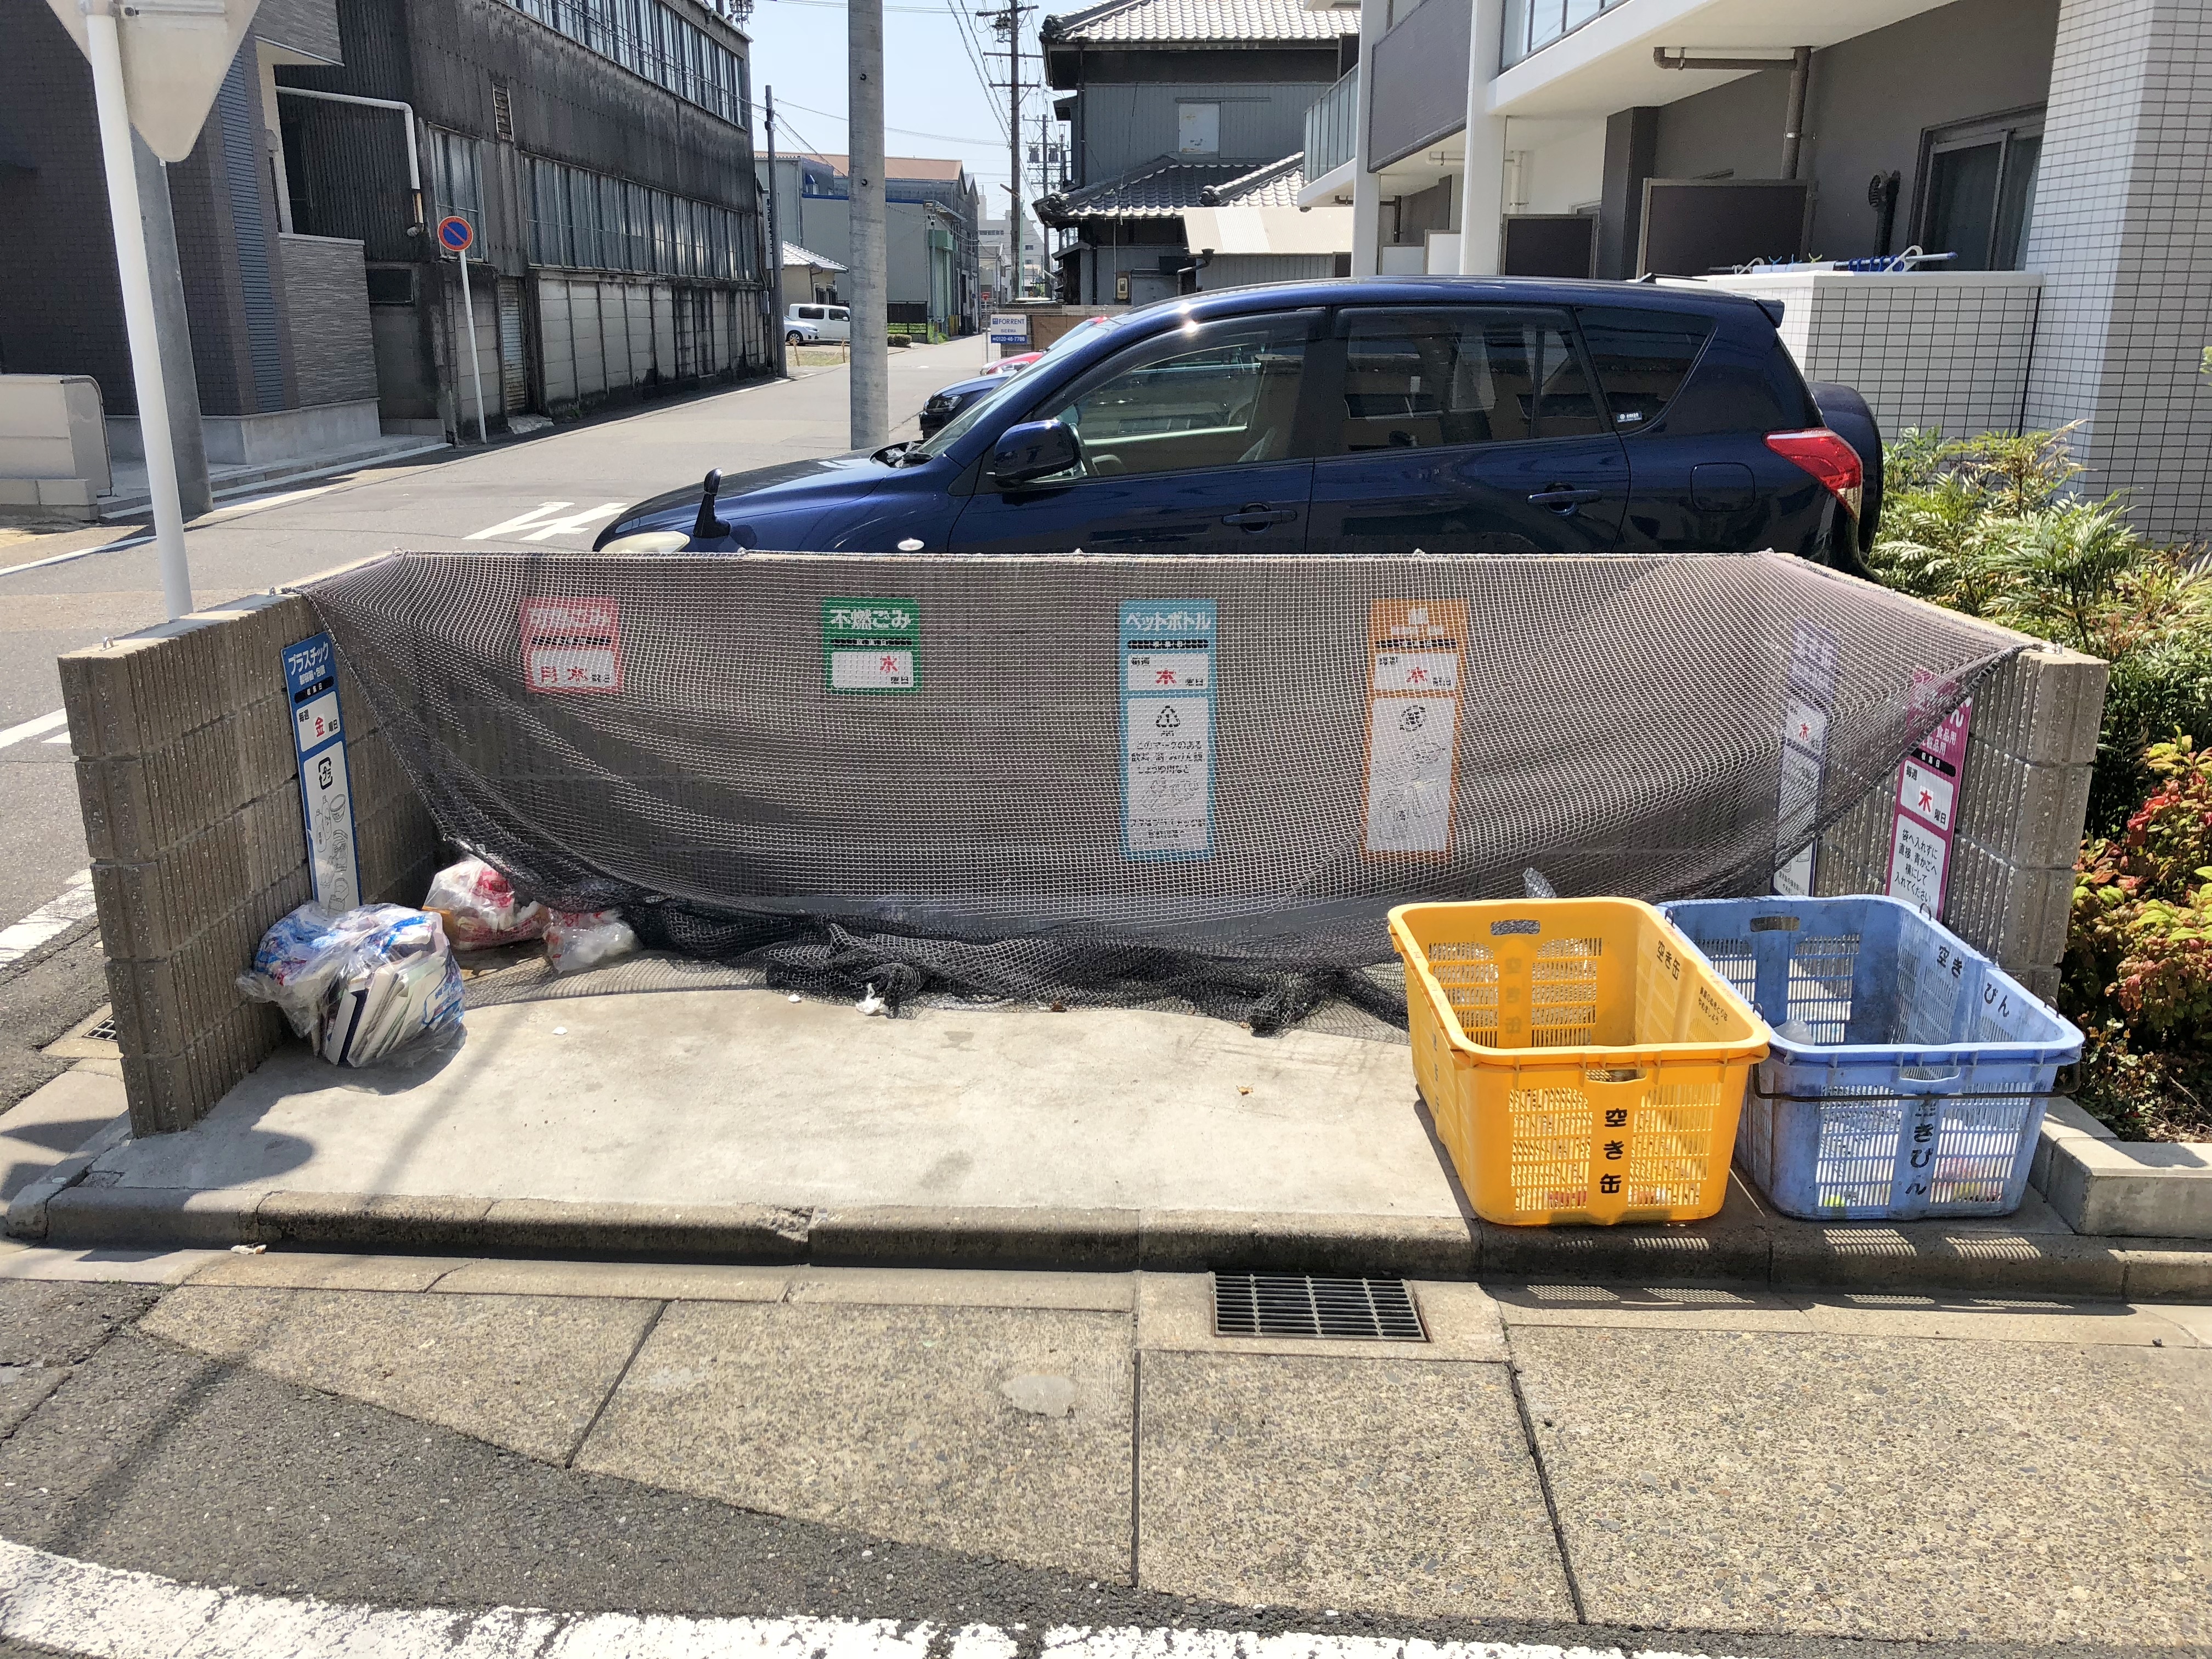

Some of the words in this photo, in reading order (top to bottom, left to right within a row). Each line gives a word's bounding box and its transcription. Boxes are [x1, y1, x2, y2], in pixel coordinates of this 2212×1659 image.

[829, 609, 911, 629] 不燃ごみ
[1126, 611, 1211, 631] ペットボトル
[288, 641, 329, 676] プラスチック
[315, 716, 325, 737] 金
[1918, 789, 1932, 812] 木
[1894, 871, 1931, 902] 入れてください
[1905, 862, 1927, 886] 横にして
[1656, 940, 1680, 981] 空き缶
[1937, 944, 1963, 979] 空き
[1984, 982, 2010, 1018] びん
[1599, 1107, 1628, 1194] 空き缶
